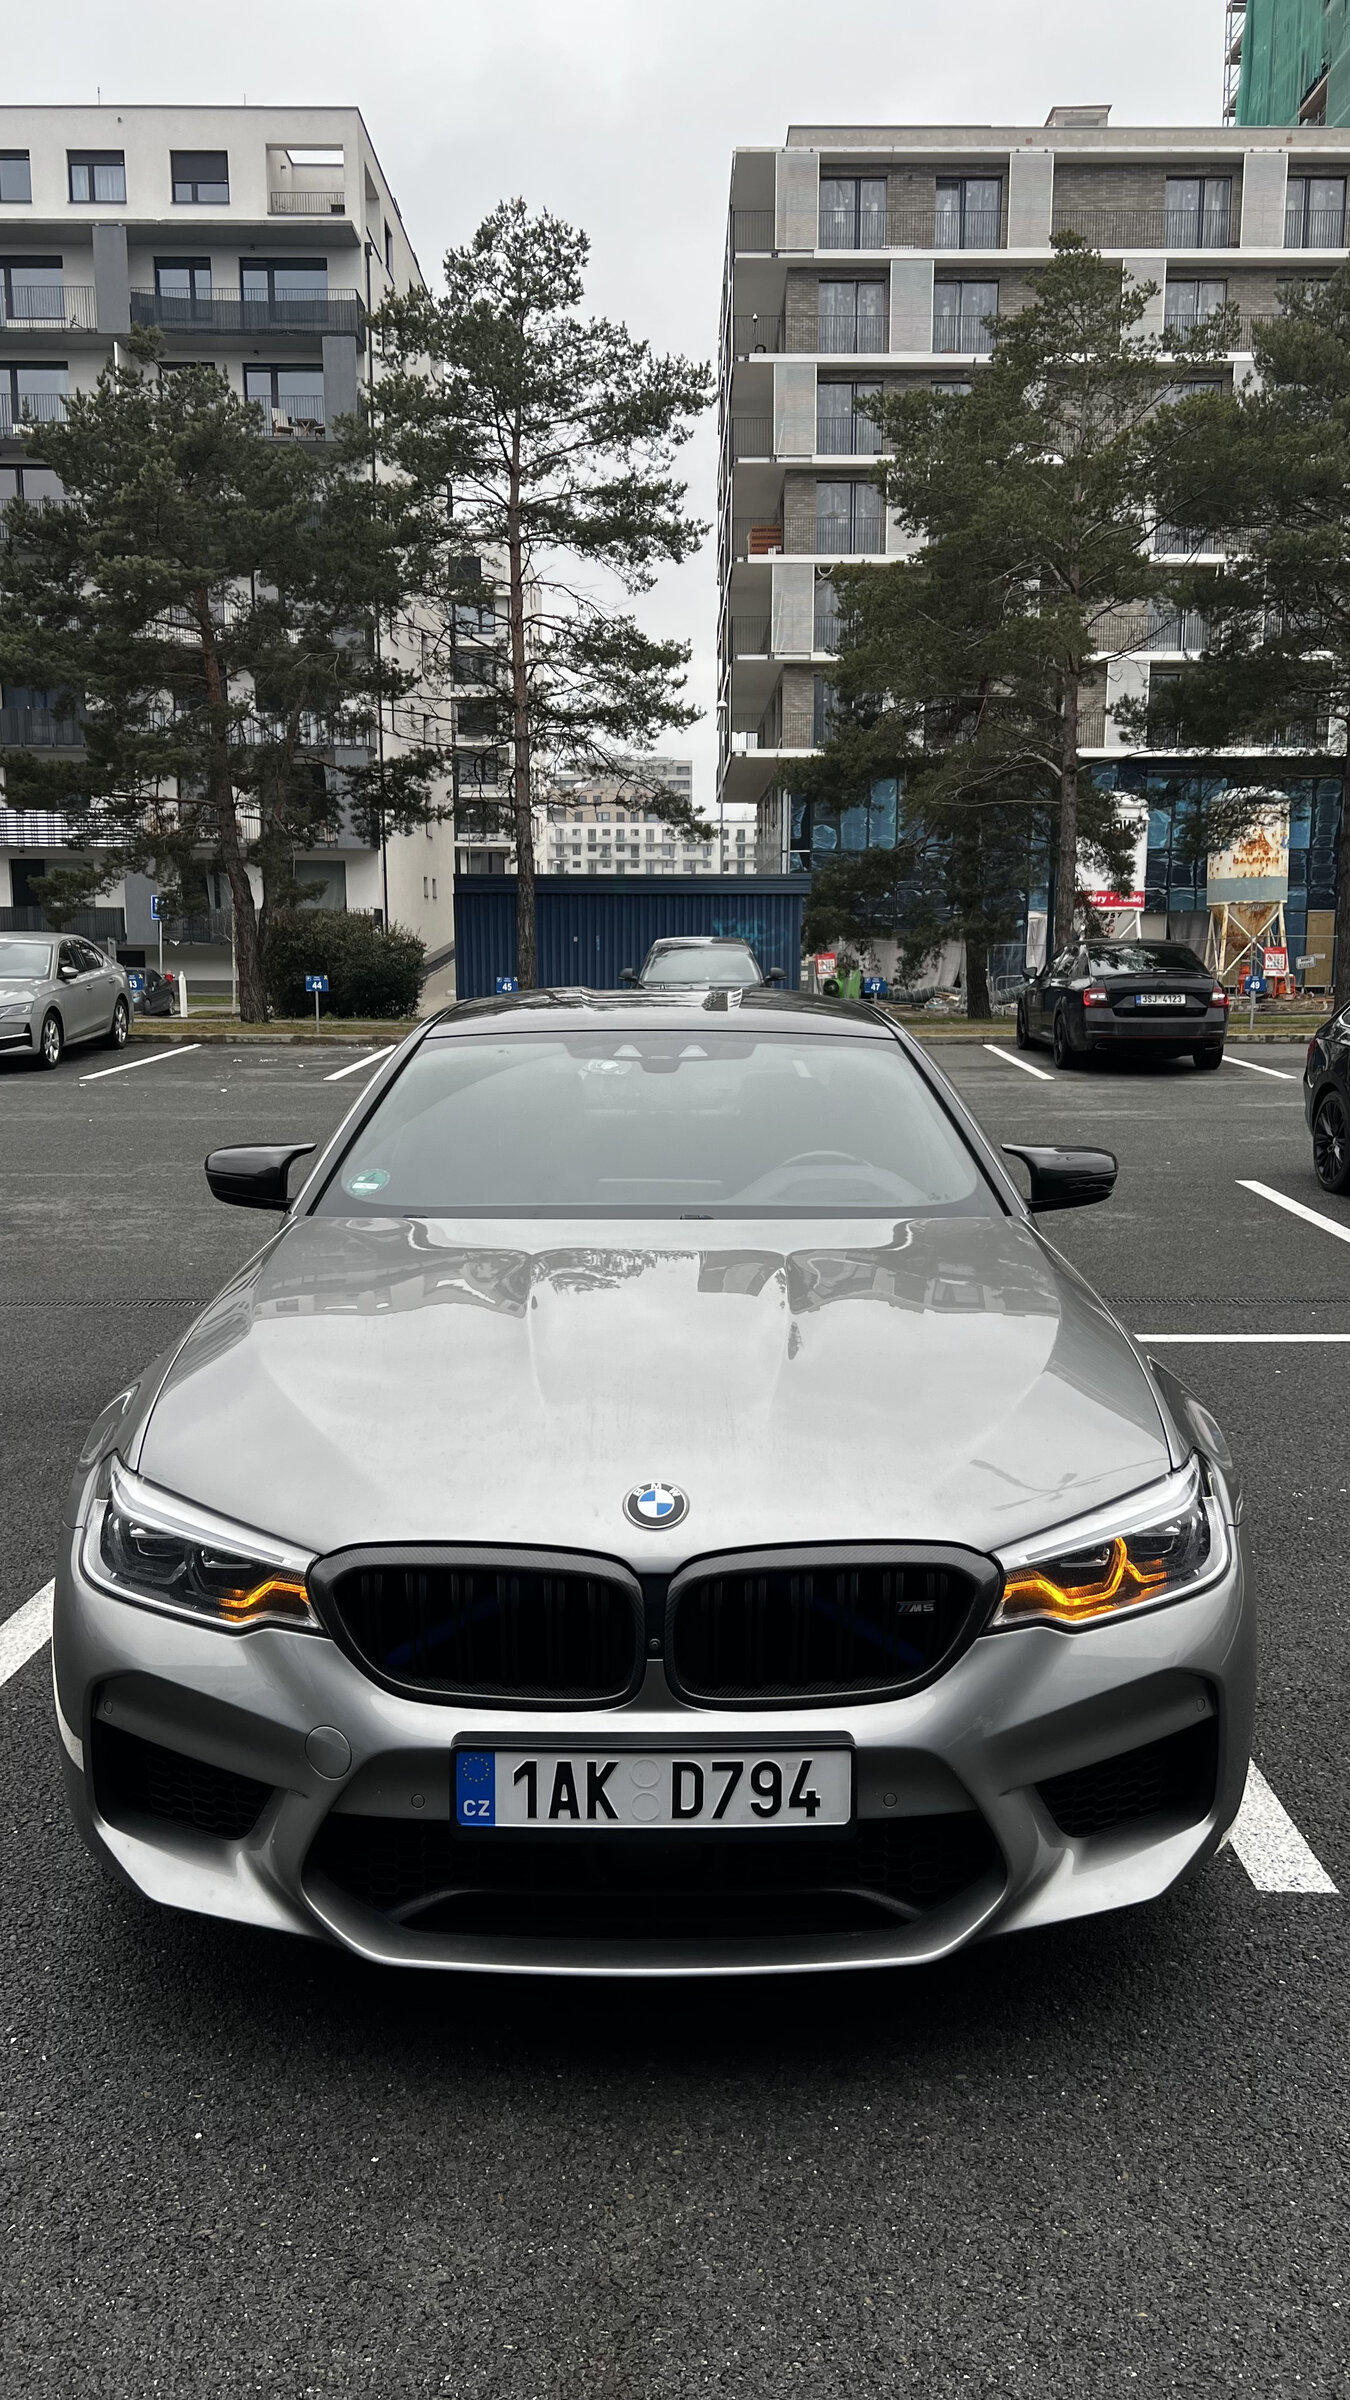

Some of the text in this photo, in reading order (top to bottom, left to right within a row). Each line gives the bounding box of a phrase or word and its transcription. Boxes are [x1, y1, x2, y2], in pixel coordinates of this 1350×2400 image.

[312, 981, 322, 989] 44
[502, 982, 512, 991] 45
[870, 983, 881, 991] 47
[1250, 981, 1260, 989] 49
[1142, 995, 1157, 1003] 3SJ
[1163, 995, 1182, 1003] 4123
[632, 1482, 681, 1497] BMW
[909, 1603, 934, 1612] M5
[513, 1759, 821, 1819] 1AK D794
[463, 1799, 490, 1817] CZ
